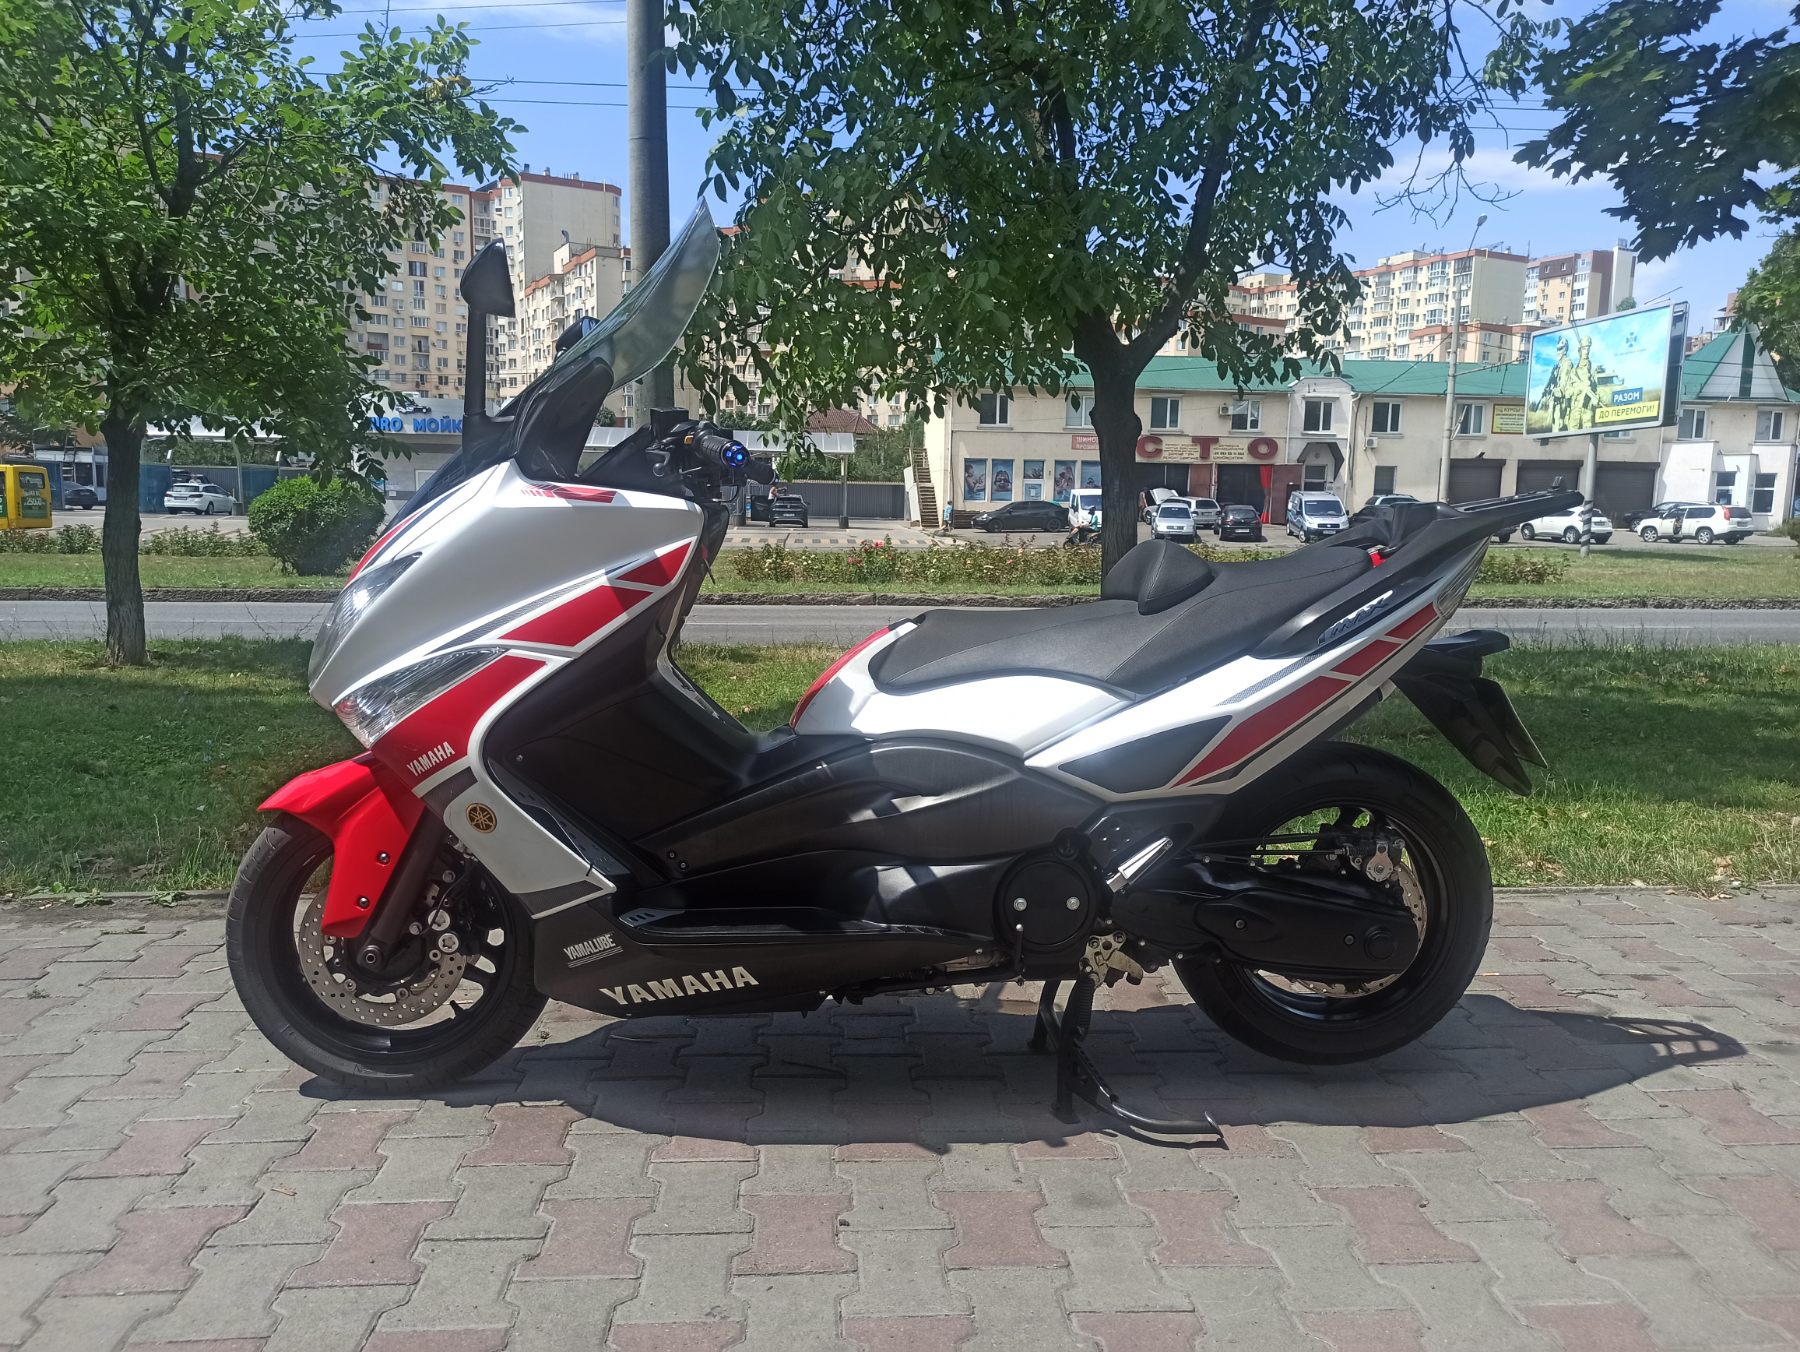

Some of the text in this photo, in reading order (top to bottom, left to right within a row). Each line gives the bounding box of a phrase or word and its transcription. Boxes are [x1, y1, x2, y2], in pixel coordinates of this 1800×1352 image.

[1613, 391, 1640, 403] РАЗОМ
[1598, 404, 1655, 420] ДО ПЕРЕМОГИ!
[412, 415, 463, 433] МОЙК
[406, 741, 456, 777] YAMAHA
[563, 933, 616, 960] YAMALUBE
[599, 966, 760, 1006] YAMAHA
